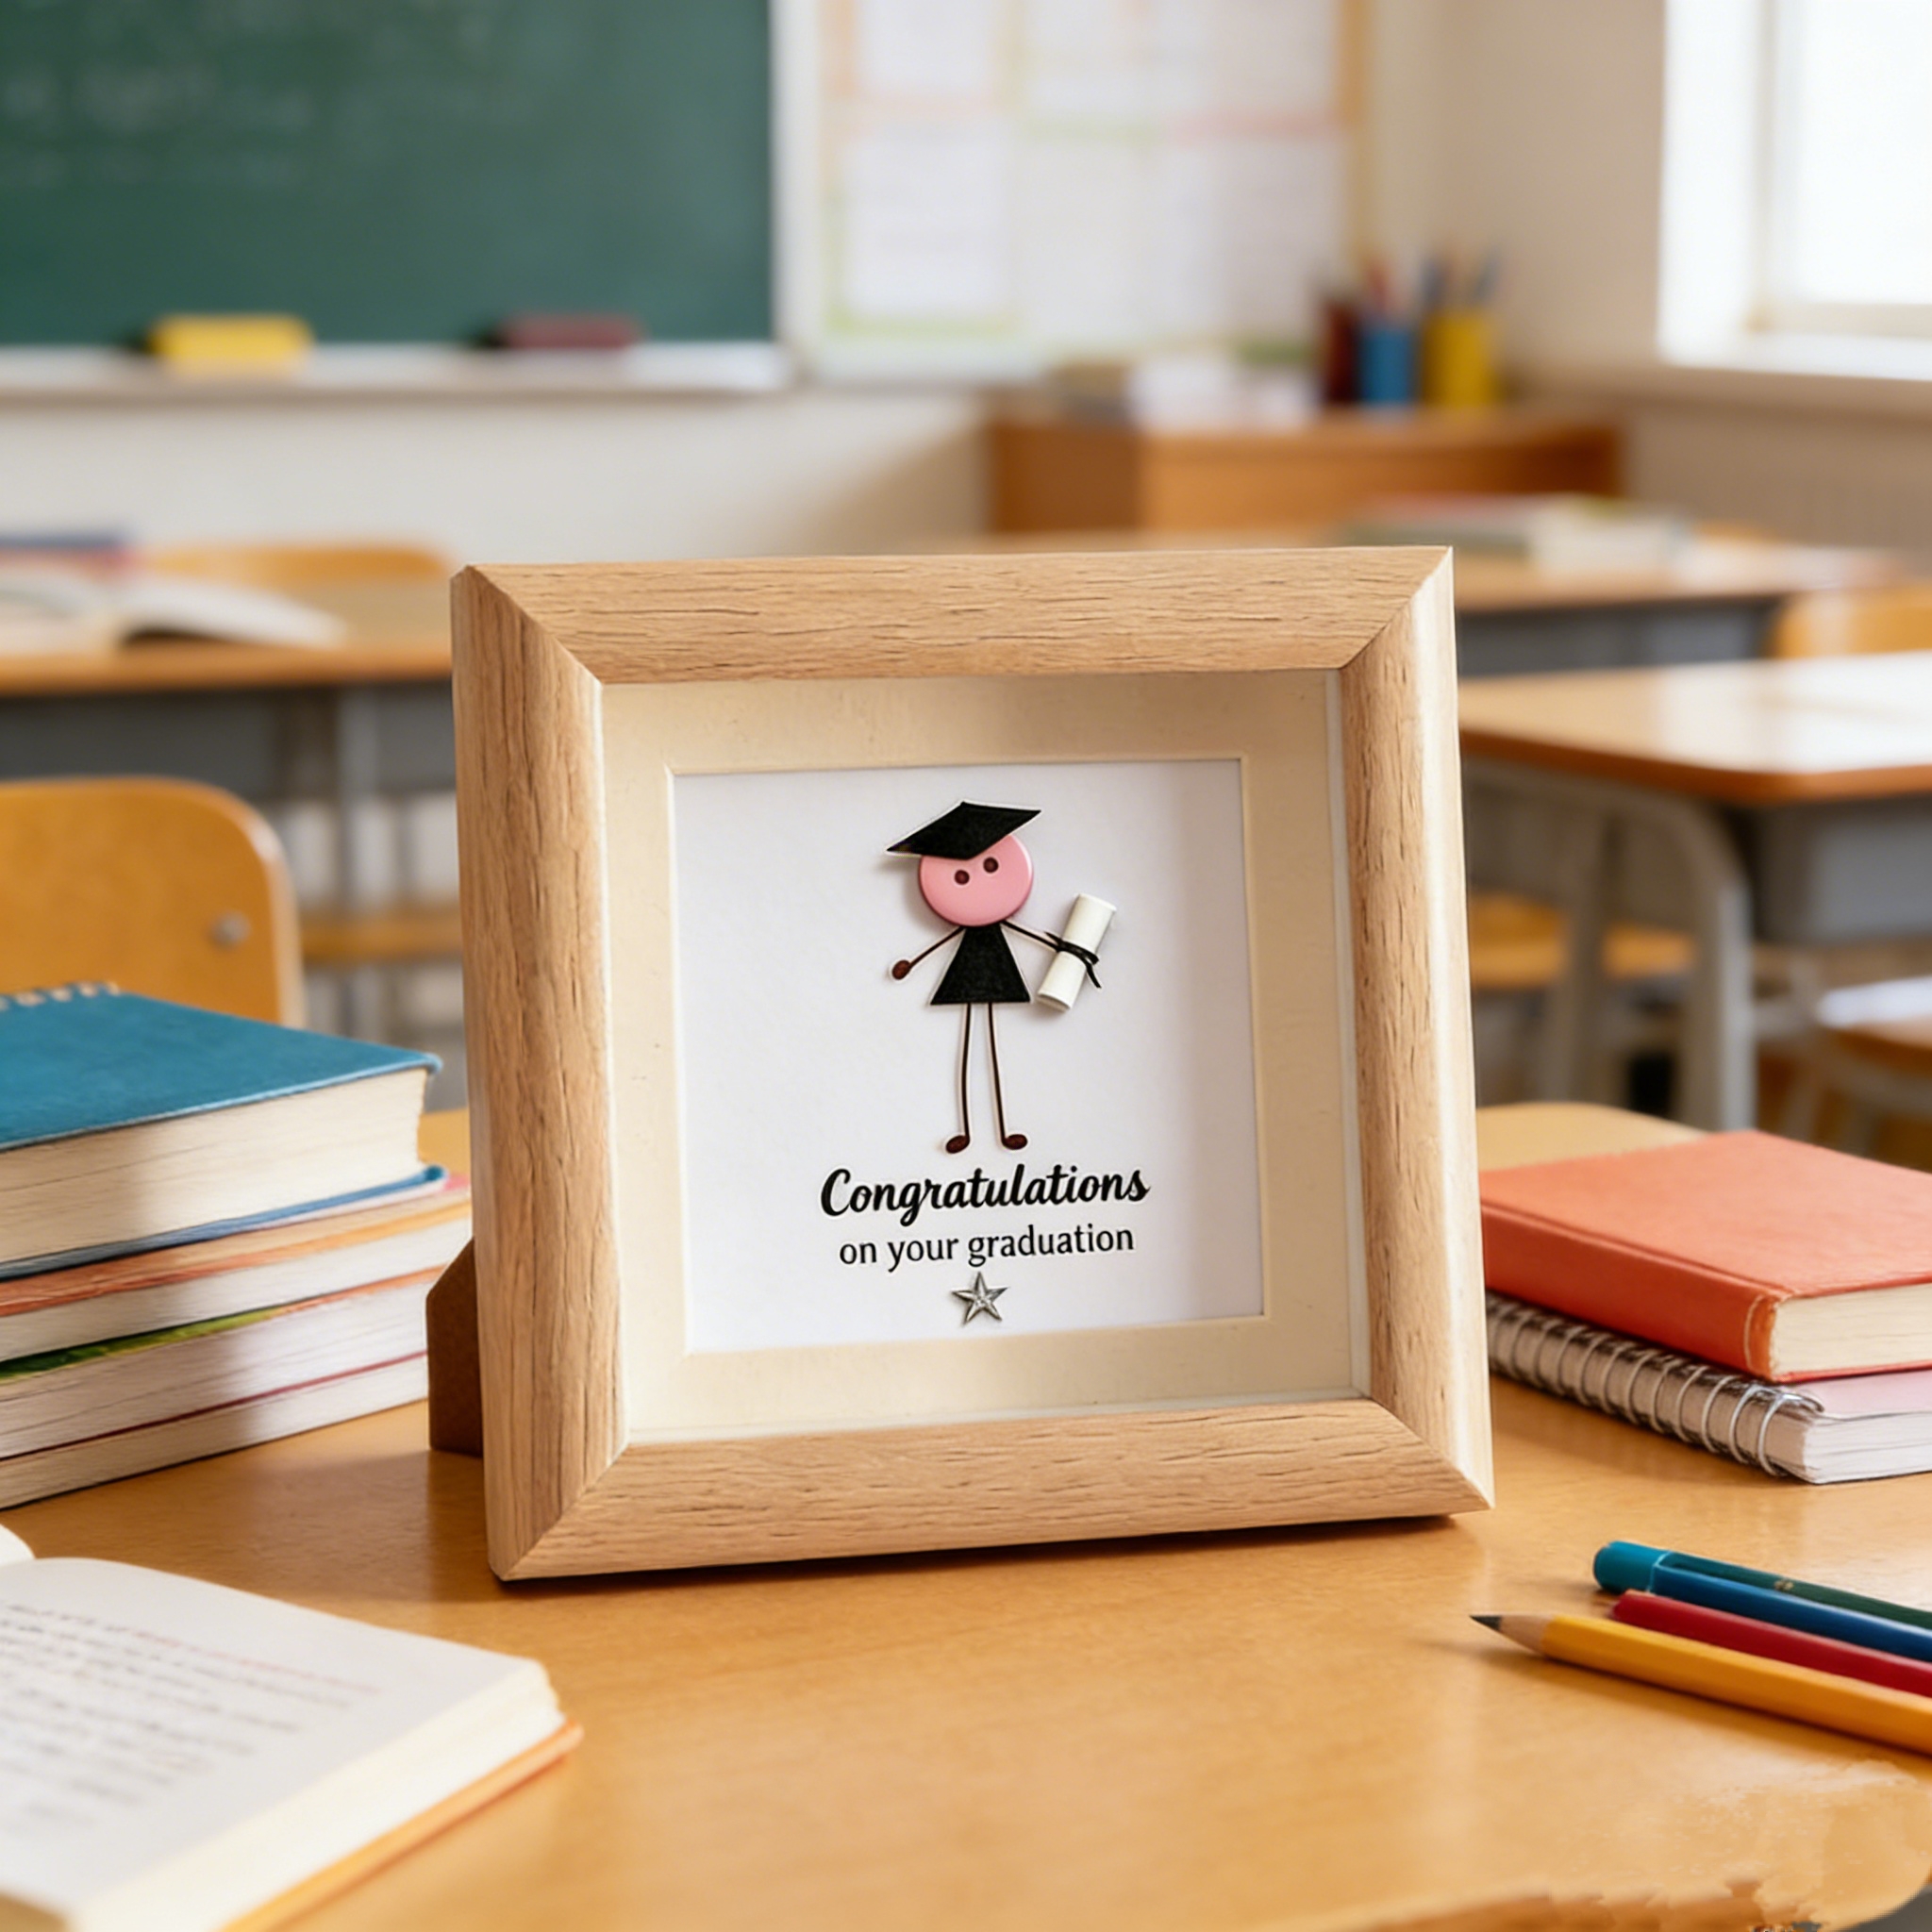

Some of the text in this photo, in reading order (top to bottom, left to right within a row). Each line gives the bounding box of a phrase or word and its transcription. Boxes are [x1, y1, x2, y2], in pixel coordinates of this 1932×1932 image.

[820, 1163, 1151, 1227] Congratulations
[839, 1223, 1135, 1274] on your graduation
